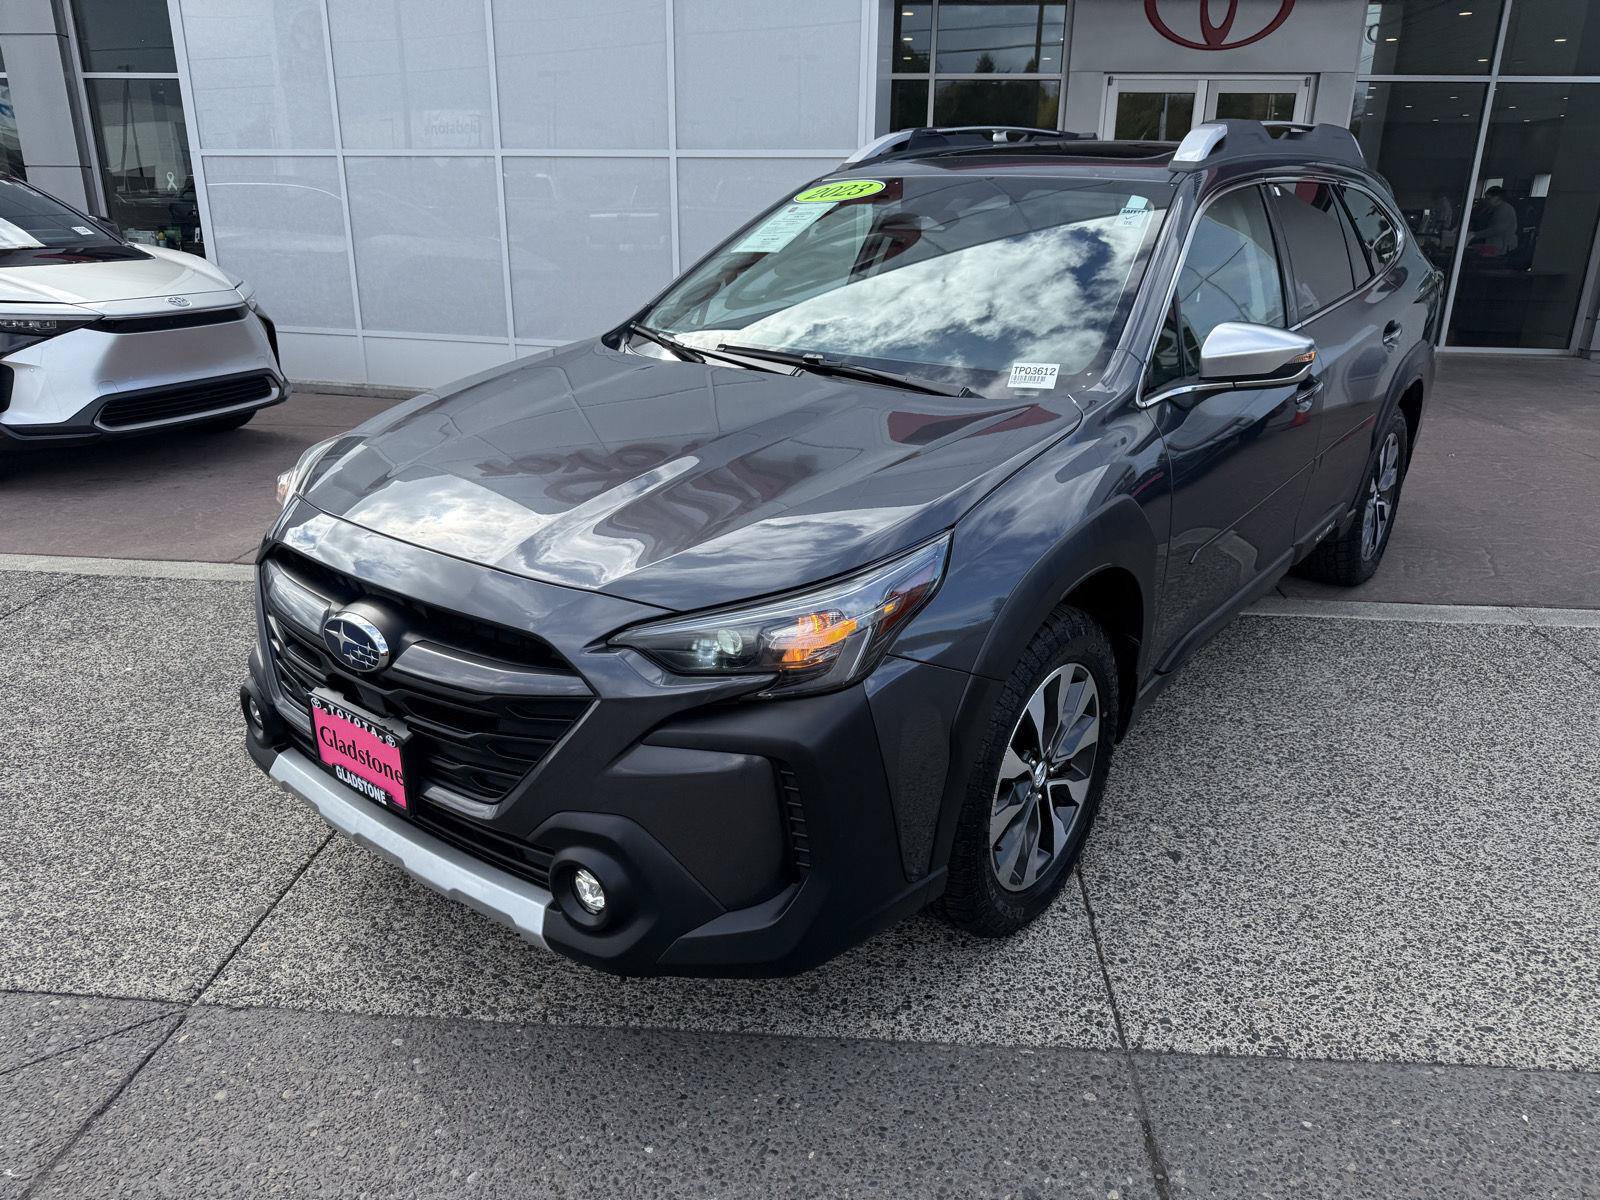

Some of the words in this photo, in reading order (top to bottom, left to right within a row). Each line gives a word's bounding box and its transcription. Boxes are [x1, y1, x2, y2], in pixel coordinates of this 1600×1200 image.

[804, 183, 874, 200] 2023
[1013, 366, 1057, 377] TP03612
[328, 704, 378, 738] TOYOTA
[320, 725, 404, 786] Gladstone
[335, 765, 388, 806] GLADSTONE
